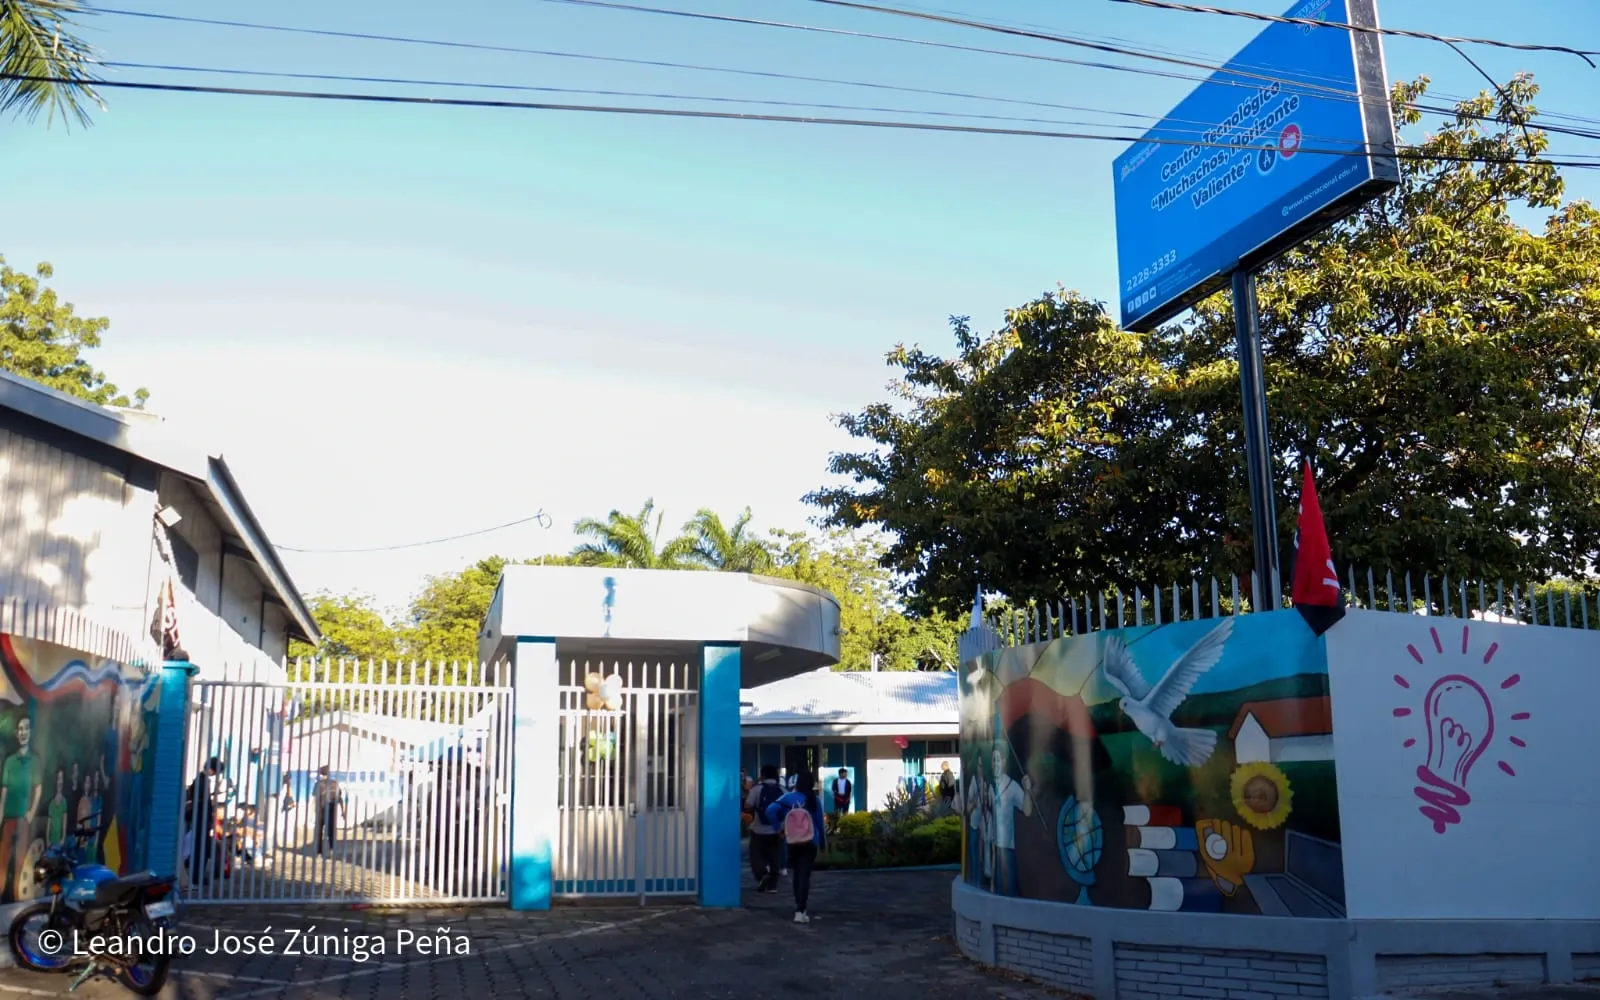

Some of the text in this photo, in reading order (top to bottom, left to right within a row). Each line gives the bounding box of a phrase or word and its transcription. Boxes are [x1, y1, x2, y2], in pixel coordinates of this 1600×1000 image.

[1161, 143, 1202, 181] Centro
[1201, 81, 1281, 147] Tecnológico
[1230, 95, 1299, 157] Horizonte
[1126, 248, 1177, 292] 2228-3333
